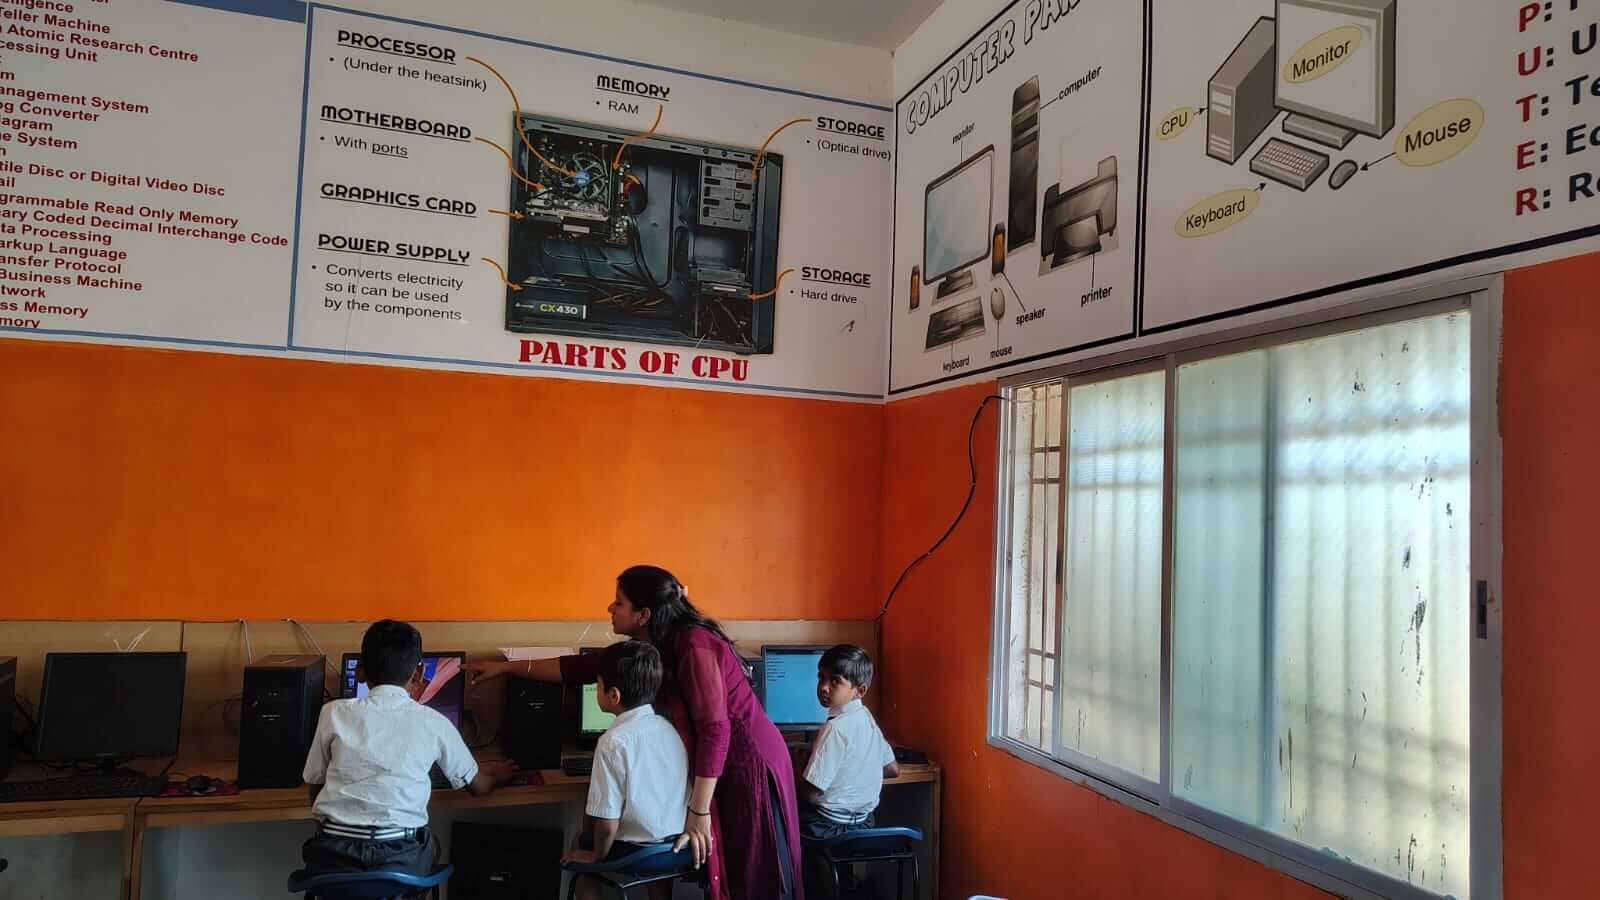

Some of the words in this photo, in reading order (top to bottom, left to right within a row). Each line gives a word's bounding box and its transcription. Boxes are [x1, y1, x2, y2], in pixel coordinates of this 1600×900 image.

[44, 14, 111, 34] Machine
[8, 24, 64, 42] Atomic
[70, 33, 144, 55] Research
[149, 45, 199, 62] Centre
[337, 30, 456, 61] PROCESSOR
[65, 47, 98, 62] Unit
[1292, 39, 1351, 80] Monitor
[344, 56, 392, 75] (Under
[397, 66, 420, 79] the
[424, 70, 487, 92] heatsink)
[905, 20, 1015, 135] COMPUTER
[1058, 66, 1102, 100] computer
[597, 75, 670, 98] MEMORY
[20, 102, 100, 122] Converter
[91, 96, 149, 114] System
[608, 100, 638, 114] RAM
[321, 105, 471, 139] MOTHERBOARD
[817, 117, 885, 138] STORAGE
[1161, 112, 1188, 136] CPU
[17, 132, 77, 149] System
[952, 123, 975, 144] monitor
[1405, 116, 1471, 152] Mouse
[334, 135, 367, 150] With
[372, 141, 408, 156] ports
[817, 140, 859, 154] (Optical
[862, 146, 891, 161] drive)
[29, 164, 64, 178] Disc
[70, 171, 86, 180] or
[91, 171, 140, 188] Digital
[145, 177, 188, 192] Video
[193, 183, 225, 196] Disc
[320, 183, 419, 207] GRAPHICS
[425, 195, 477, 214] CARD
[95, 201, 134, 216] Read
[139, 206, 174, 222] Only
[179, 211, 239, 229] Memory
[1185, 197, 1246, 231] Keyboard
[22, 224, 112, 245] Processing
[33, 210, 85, 225] Coded
[91, 216, 152, 233] Decimal
[158, 223, 246, 244] Interchange
[251, 232, 289, 246] Code
[49, 241, 127, 260] Language
[318, 234, 390, 254] POWER
[396, 242, 470, 263] SUPPLY
[54, 258, 121, 274] Protocol
[326, 264, 393, 281] Converts
[397, 272, 464, 290] electricity
[801, 266, 871, 284] STORAGE
[0, 269, 71, 285] Business
[77, 275, 143, 291] Machine
[325, 281, 343, 293] so
[347, 283, 356, 294] it
[361, 286, 387, 297] can
[392, 286, 409, 299] be
[414, 290, 449, 303] used
[800, 289, 826, 301] Hard
[830, 294, 857, 304] drive
[1081, 286, 1112, 307] printer
[24, 301, 88, 318] Memory
[324, 296, 341, 311] by
[347, 297, 369, 312] the
[374, 303, 462, 320] components
[1015, 307, 1046, 325] speaker
[519, 339, 626, 370] PARTS
[639, 351, 680, 374] OF
[691, 355, 749, 381] CPU
[990, 345, 1013, 360] mouse
[943, 356, 970, 372] keyboard
